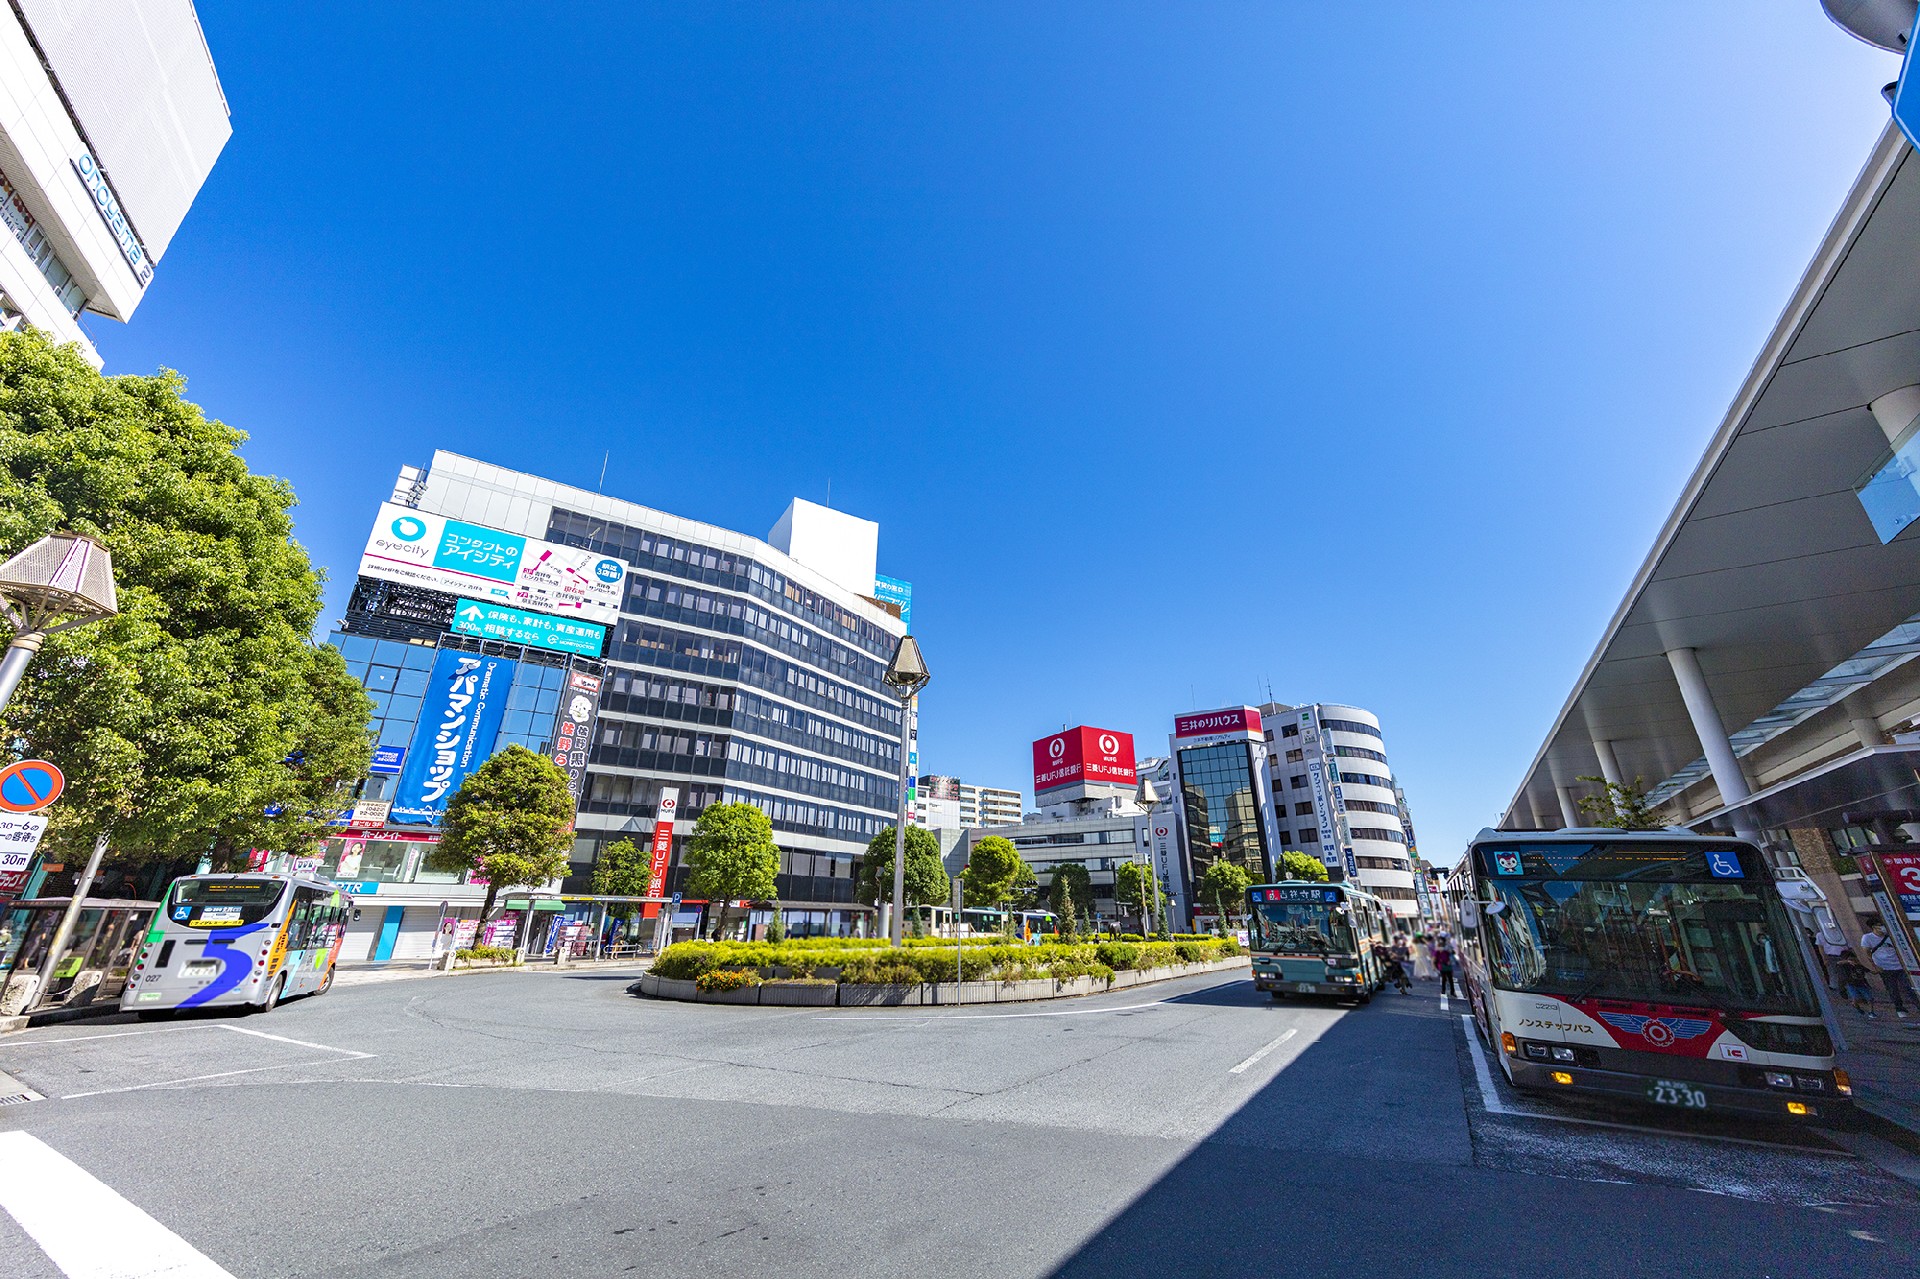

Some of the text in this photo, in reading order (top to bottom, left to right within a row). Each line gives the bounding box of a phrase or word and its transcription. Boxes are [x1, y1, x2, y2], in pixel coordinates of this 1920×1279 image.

[375, 539, 430, 558] eyecity
[446, 533, 518, 557] コンタクトの
[443, 543, 515, 570] アイシティ
[484, 623, 540, 641] 相談するなら
[487, 610, 601, 640] 保険も、家計も、資産運用も
[459, 662, 498, 768] Dramatic Communication
[1181, 714, 1240, 732] 三井のリハウス
[420, 657, 482, 803] アパマンショップ
[1035, 763, 1082, 784] 三菱UFJ信託銀行
[1086, 763, 1134, 778] 三菱UFJ信託銀行
[360, 830, 402, 841] ホームメイト
[649, 829, 670, 898] 三菱UFJ銀行
[145, 974, 162, 983] 027
[1518, 1018, 1594, 1034] ノンステップバス
